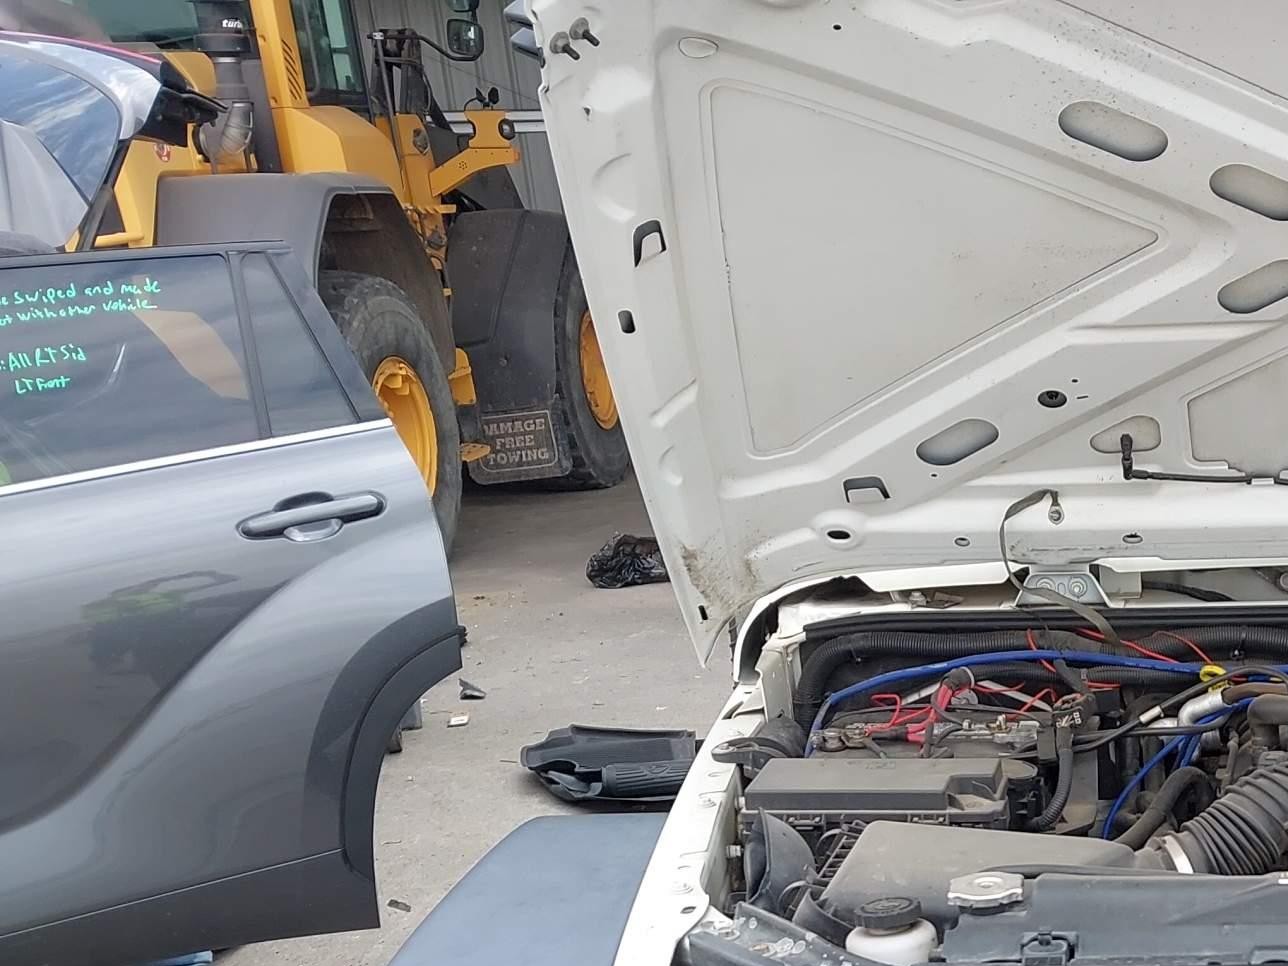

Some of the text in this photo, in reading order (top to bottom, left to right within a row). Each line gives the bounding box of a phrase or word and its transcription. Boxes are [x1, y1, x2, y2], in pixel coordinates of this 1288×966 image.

[85, 281, 114, 297] and
[8, 352, 32, 372] All
[495, 434, 535, 450] FREE
[487, 447, 549, 465] TOWING
